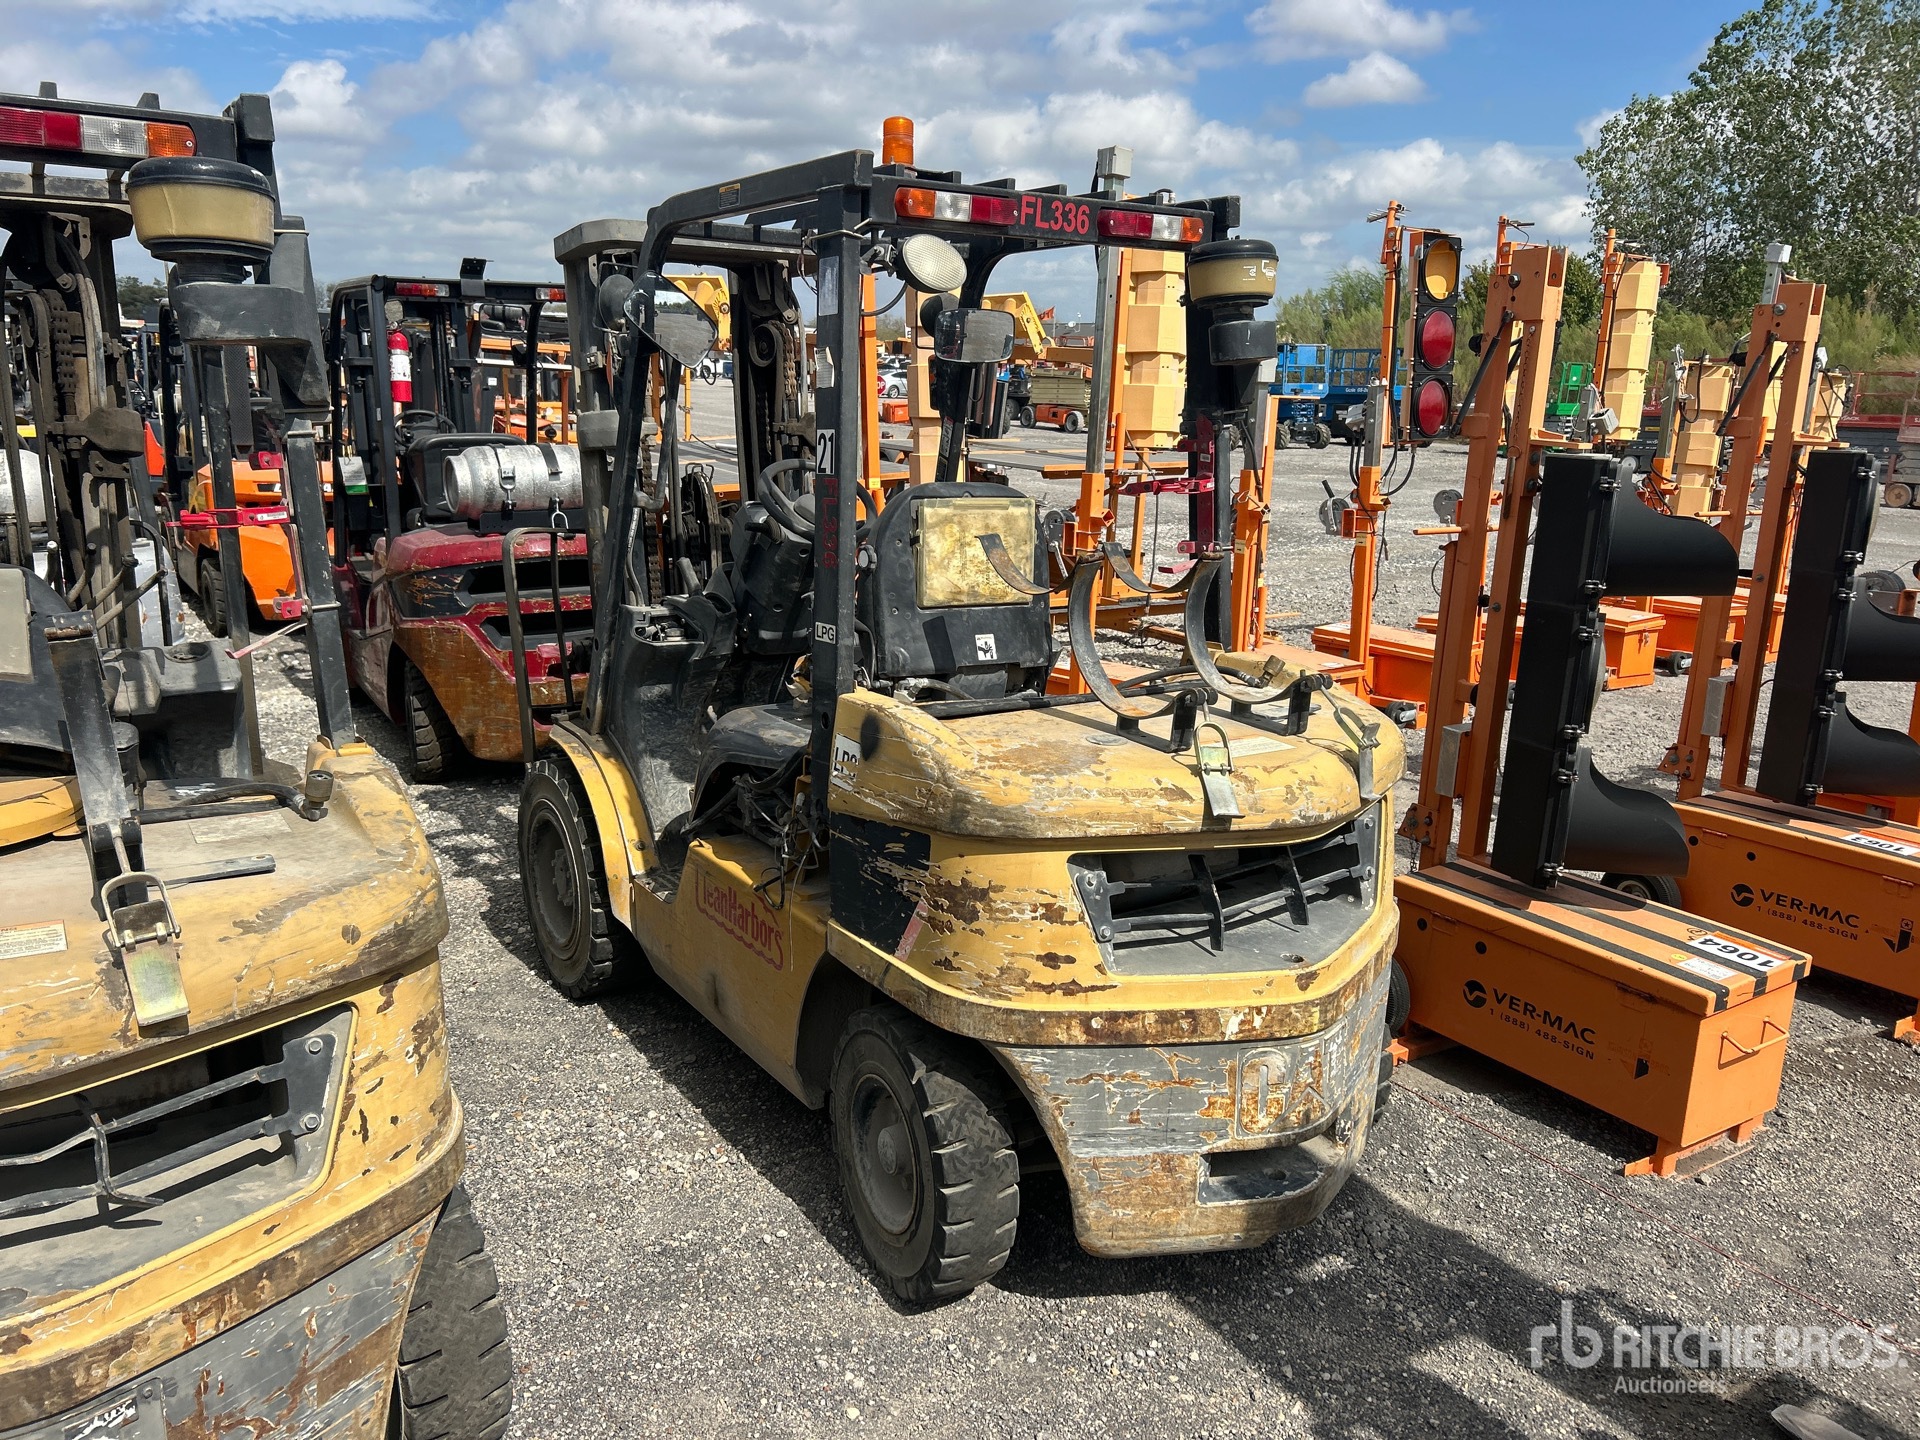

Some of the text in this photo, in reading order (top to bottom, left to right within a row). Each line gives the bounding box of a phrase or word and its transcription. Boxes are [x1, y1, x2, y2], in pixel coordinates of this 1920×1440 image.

[1020, 195, 1090, 235] FL336
[817, 432, 835, 474] 21
[822, 477, 839, 570] FL336
[816, 624, 836, 641] LPG
[1850, 835, 1907, 853] 1063
[1760, 888, 1861, 929] VER-MAC
[1767, 908, 1797, 923] (888)
[1801, 918, 1859, 941] 488-SIGN
[1698, 937, 1775, 968] 1064
[1490, 1008, 1495, 1016] 1
[1500, 1012, 1530, 1032] (888)
[1535, 1029, 1595, 1061] 488-SIGN
[1492, 987, 1597, 1045] VER-MAC
